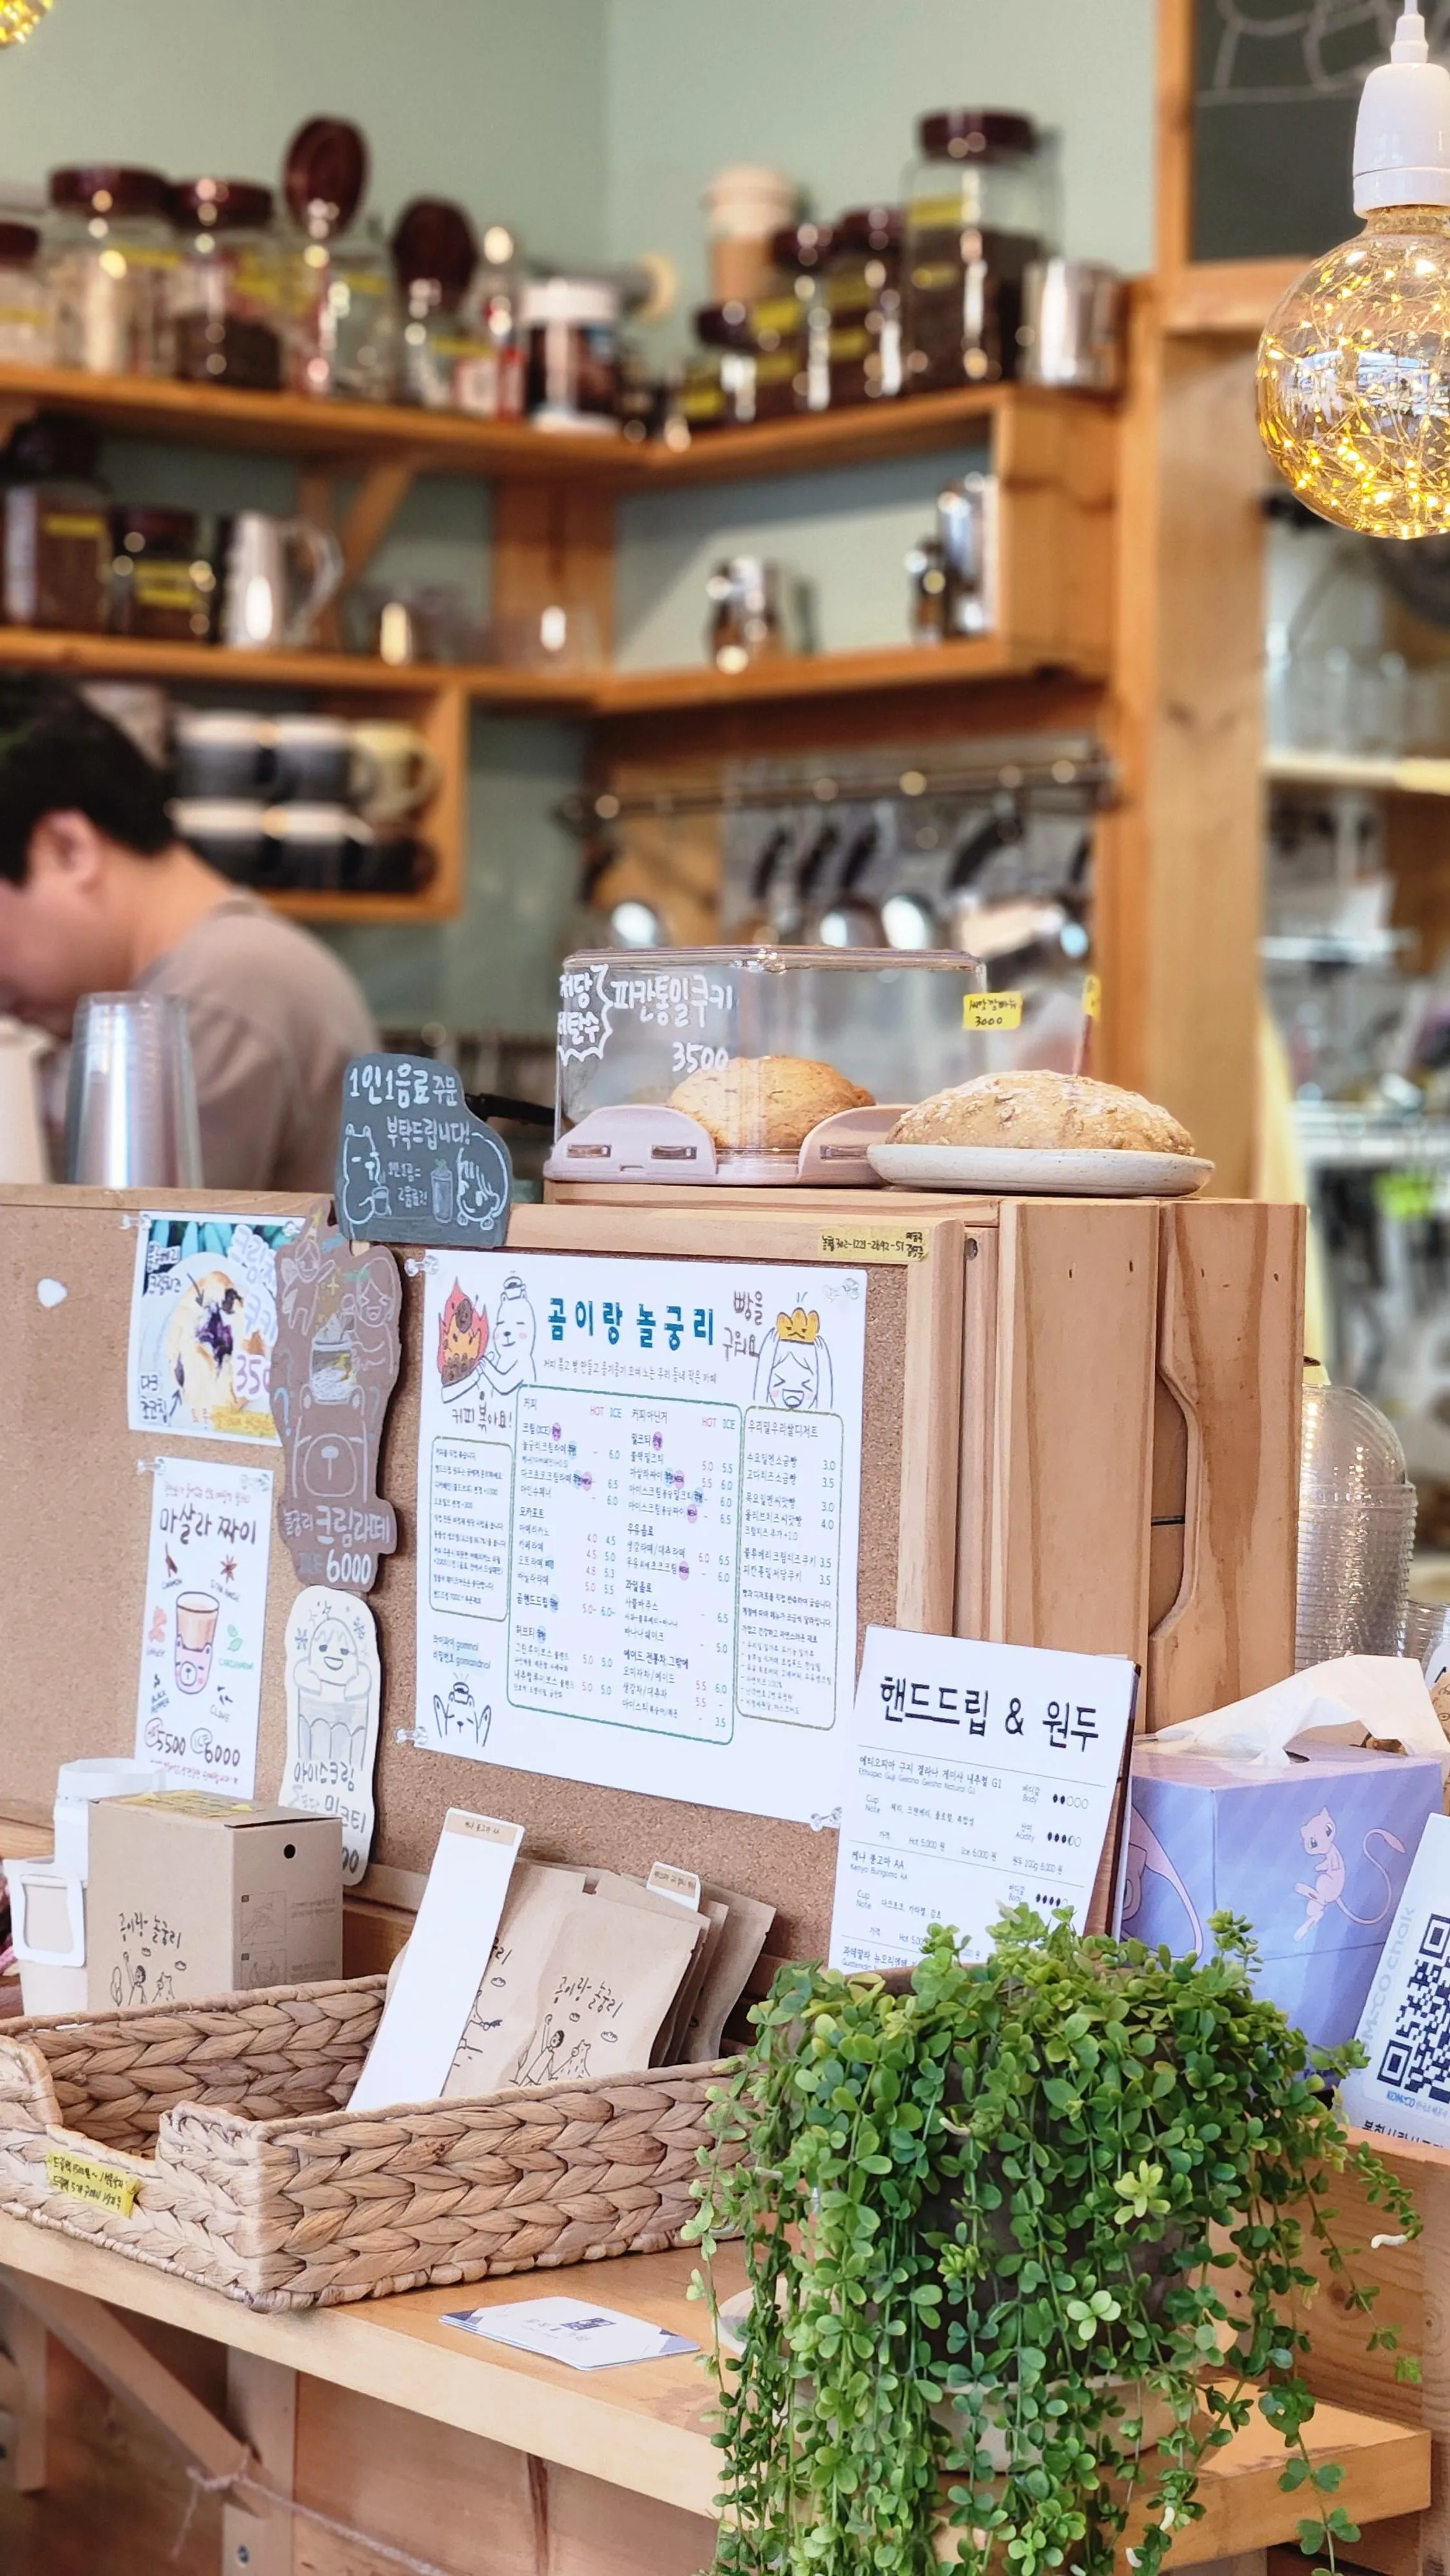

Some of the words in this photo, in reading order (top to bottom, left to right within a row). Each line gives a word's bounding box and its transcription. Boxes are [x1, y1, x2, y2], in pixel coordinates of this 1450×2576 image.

[611, 975, 733, 1028] 피칸통밀쿠키
[975, 1016, 1003, 1027] 3000
[672, 1041, 729, 1073] 3500
[432, 1075, 458, 1106] 주문
[386, 1116, 471, 1150] 부탁드립니다!
[733, 1291, 764, 1327] 빵을
[547, 1298, 623, 1345] 곰이랑
[636, 1303, 713, 1351] 놀궁리
[523, 1397, 537, 1410] 커피
[451, 1407, 475, 1425] 커피
[590, 1406, 605, 1416] HOT
[609, 1407, 623, 1419] ICE
[701, 1417, 717, 1428] HOT
[722, 1418, 736, 1430] ICE
[631, 1433, 651, 1446] 밀크티
[608, 1449, 620, 1461] 6.0
[630, 1450, 664, 1464] 블랙밀크티
[702, 1460, 713, 1472] 5.0
[722, 1463, 733, 1474] 5.5
[822, 1459, 836, 1471] 3.0
[607, 1479, 619, 1490] 6.5
[701, 1477, 713, 1489] 5.5
[720, 1479, 733, 1491] 6.0
[822, 1477, 834, 1489] 3.5
[607, 1495, 618, 1506] 6.0
[720, 1496, 732, 1508] 6.0
[821, 1501, 835, 1513] 3.0
[160, 1503, 212, 1545] 마살라
[217, 1515, 256, 1544] 짜이
[720, 1513, 731, 1525] 6.5
[821, 1519, 834, 1530] 4.0
[315, 1505, 390, 1548] 크림라떼
[519, 1524, 550, 1537] 아메리카노
[587, 1533, 598, 1544] 4.0
[605, 1535, 616, 1546] 4.5
[586, 1549, 597, 1560] 4.5
[605, 1551, 616, 1562] 5.0
[698, 1552, 710, 1564] 6.0
[719, 1555, 730, 1566] 6.5
[326, 1548, 372, 1585] 6000
[819, 1557, 832, 1569] 3.5
[717, 1571, 730, 1583] 6.0
[818, 1574, 831, 1586] 3.5
[717, 1612, 729, 1624] 6.5
[716, 1642, 728, 1654] 5.0
[583, 1654, 594, 1665] 5.0
[601, 1656, 613, 1668] 5.0
[581, 1681, 593, 1692] 5.0
[600, 1684, 612, 1696] 5.0
[695, 1680, 707, 1691] 5.5
[715, 1683, 728, 1694] 6.0
[695, 1696, 707, 1708] 5.5
[880, 1676, 989, 1737] 핸드드립
[1004, 1697, 1024, 1736] &
[1042, 1701, 1099, 1752] 원두
[715, 1716, 726, 1728] 3.5
[158, 1730, 186, 1756] 5500
[205, 1742, 241, 1767] 6000
[859, 1755, 896, 1771] 에티오피아
[991, 1778, 1002, 1789] G1
[865, 1794, 880, 1807] Cup
[893, 1859, 905, 1870] AA
[857, 1889, 870, 1900] Cup
